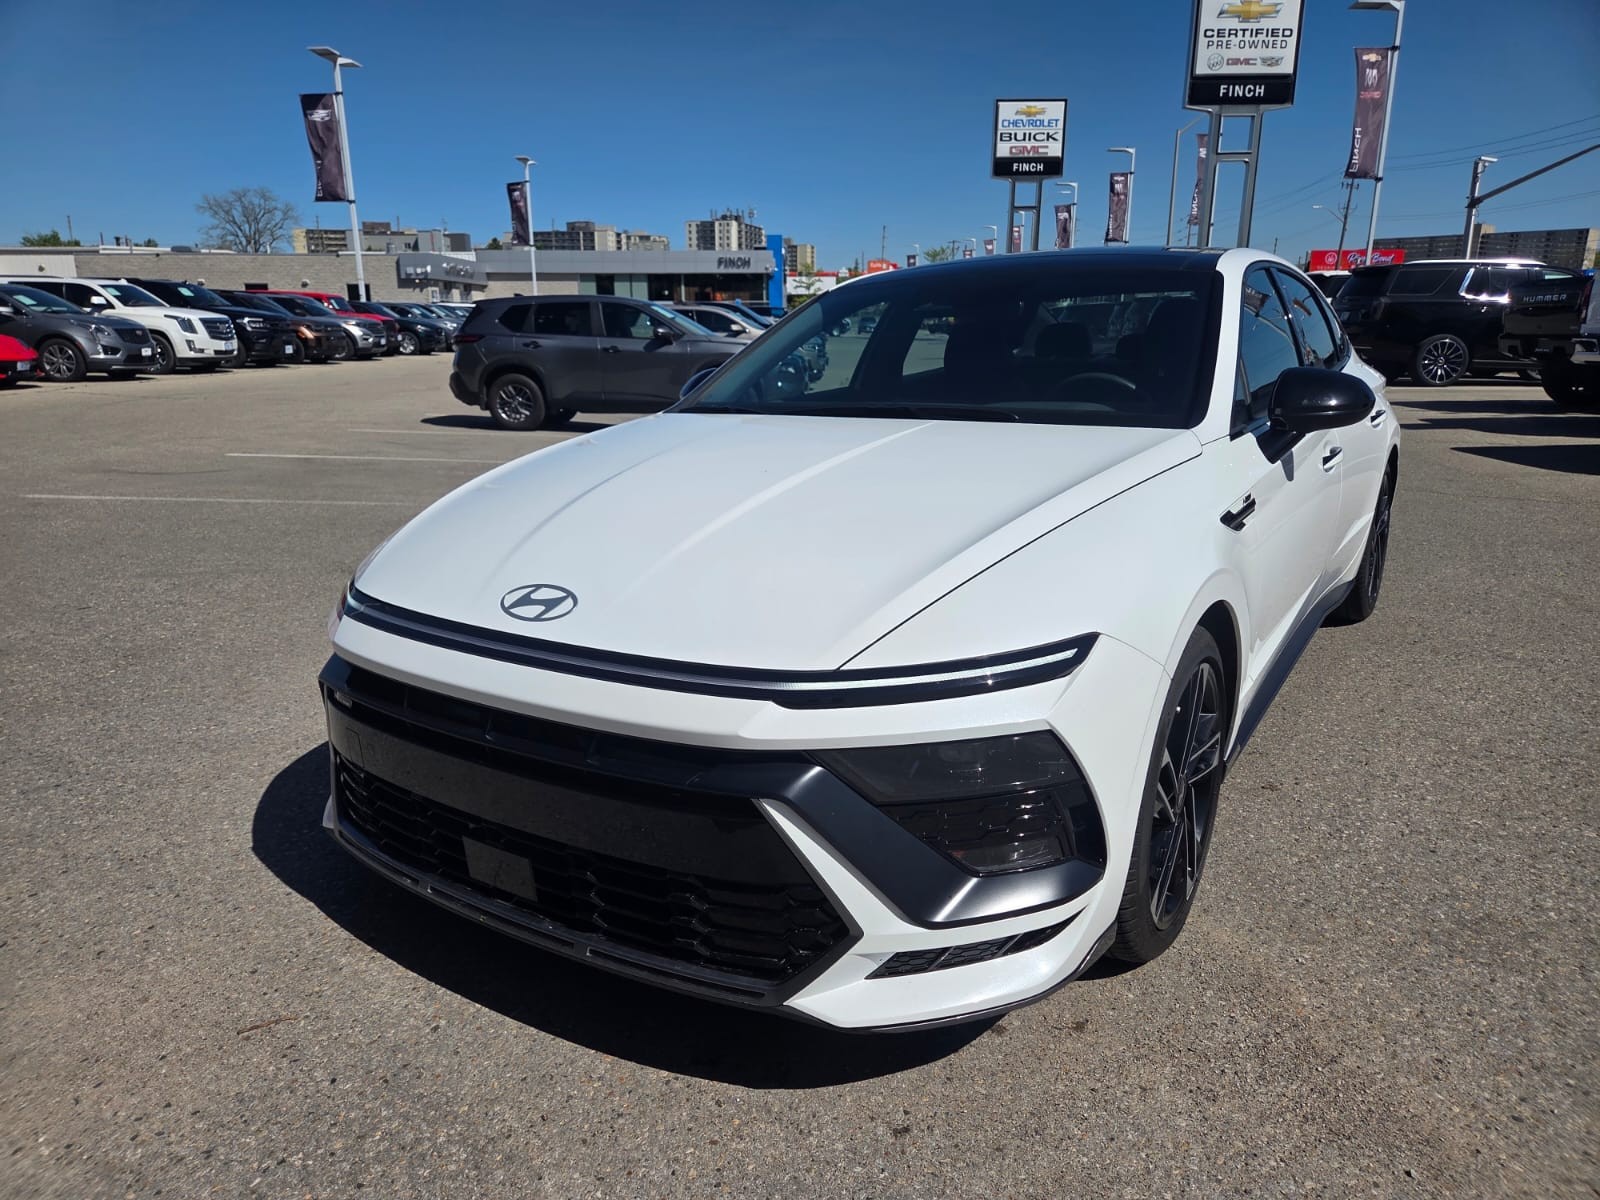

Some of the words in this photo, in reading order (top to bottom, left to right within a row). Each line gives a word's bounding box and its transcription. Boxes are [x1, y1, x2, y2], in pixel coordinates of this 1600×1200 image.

[1203, 28, 1293, 39] CERTIFIED
[1206, 40, 1288, 49] PRE-OWNED
[1226, 58, 1258, 66] GMC
[1219, 85, 1265, 97] FINCH
[1001, 118, 1060, 128] CHEVROLET
[1000, 132, 1059, 142] BUICK
[1009, 145, 1049, 156] GMC
[1012, 162, 1044, 172] FINCH
[717, 257, 751, 269] FINCH
[1523, 294, 1567, 302] HUMMER
